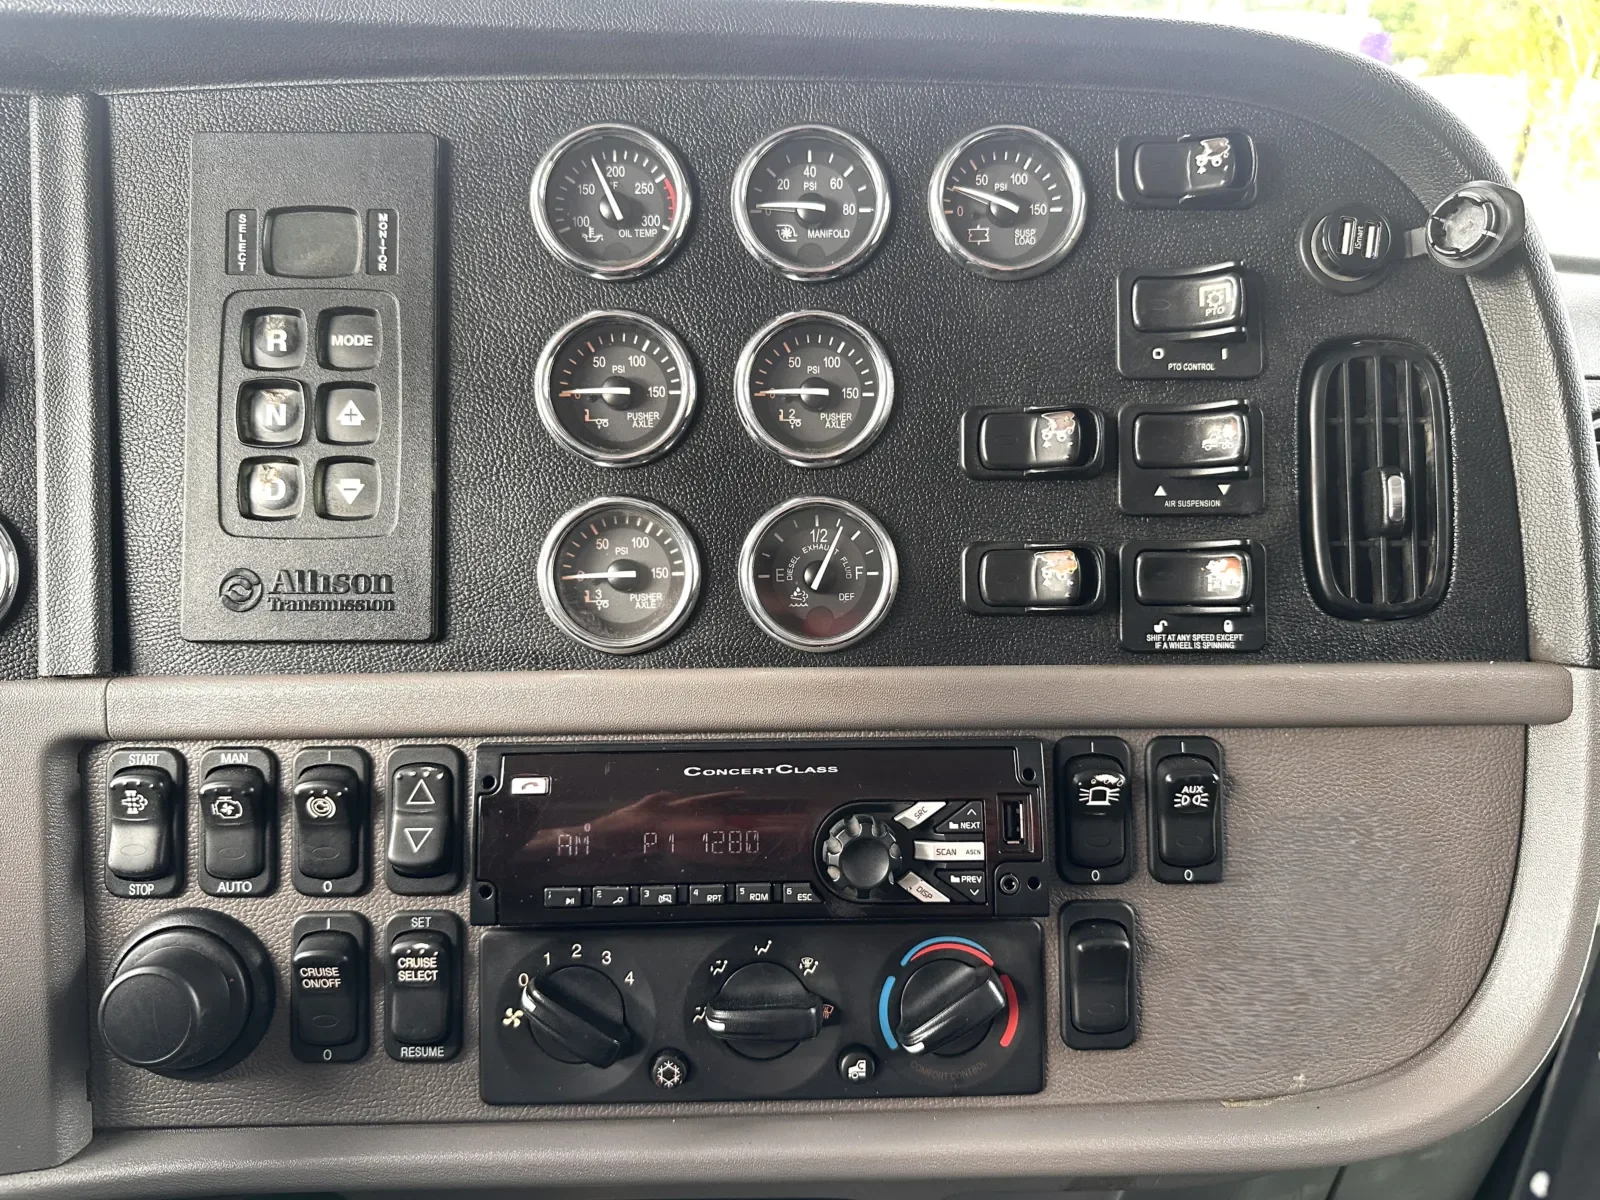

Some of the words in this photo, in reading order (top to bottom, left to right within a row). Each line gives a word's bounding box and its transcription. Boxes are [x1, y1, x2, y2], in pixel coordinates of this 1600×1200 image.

[606, 166, 625, 178] 200
[803, 166, 816, 178] 40
[777, 178, 790, 190] 20
[830, 178, 843, 190] 60
[976, 174, 988, 186] 50
[1010, 174, 1028, 185] 100
[578, 184, 595, 195] 150
[634, 183, 654, 195] 250
[804, 182, 817, 190] PSI
[994, 183, 1008, 191] PSI
[842, 204, 856, 215] 80
[956, 205, 964, 216] 0
[1029, 204, 1047, 215] 150
[572, 216, 590, 227] 100
[642, 216, 660, 227] 300
[618, 229, 632, 238] OIL
[635, 229, 658, 237] TEMP
[807, 229, 850, 238] MANIFOLD
[1014, 229, 1036, 238] SUSP
[238, 214, 248, 272] SELECT
[378, 214, 388, 272] MONITOR
[1014, 237, 1036, 245] LOAD
[1205, 306, 1224, 316] PTO
[266, 330, 287, 352] R
[331, 334, 373, 347] MODE
[592, 356, 606, 367] 50
[628, 356, 646, 367] 100
[788, 356, 801, 368] 50
[823, 356, 841, 368] 100
[1168, 363, 1182, 371] PTO
[1183, 363, 1215, 371] CONTROL
[612, 365, 625, 373] PSI
[807, 366, 820, 374] PSI
[648, 386, 665, 397] 150
[842, 388, 859, 399] 150
[265, 404, 287, 426] N
[627, 412, 660, 420] PUSHER
[820, 412, 852, 421] PUSHER
[632, 420, 654, 428] AXLE
[825, 420, 846, 428] AXLE
[264, 477, 286, 500] D
[810, 528, 828, 543] 1/2
[596, 539, 609, 550] 50
[631, 537, 649, 548] 100
[615, 547, 628, 555] PSI
[787, 556, 800, 580] DIESEL
[802, 544, 840, 555] EXHAUT
[840, 556, 852, 579] FLUID
[651, 568, 668, 578] 150
[776, 568, 784, 582] E
[855, 566, 863, 580] F
[268, 569, 395, 595] Allison
[630, 593, 662, 601] PUSHER
[839, 593, 855, 601] DEF
[268, 597, 395, 612] Transmission
[635, 601, 657, 609] AXLE
[128, 754, 159, 765] START
[221, 753, 249, 764] MAN
[1181, 785, 1204, 794] AUX
[914, 806, 928, 820] SRC
[558, 834, 590, 856] AM
[702, 830, 760, 854] 1280
[936, 848, 957, 856] SCAN
[128, 884, 154, 895] STOP
[217, 882, 252, 893] AUTO
[916, 885, 933, 900] DISP
[707, 894, 722, 902] RPT
[411, 917, 432, 928] SET
[571, 944, 582, 958] 2
[398, 957, 438, 968] CRUISE
[543, 952, 551, 966] 1
[601, 951, 612, 965] 3
[300, 967, 340, 977] CRUISE
[397, 970, 438, 981] SELECT
[302, 978, 341, 989] ON/OFF
[518, 973, 529, 987] 0
[624, 971, 634, 985] 4
[400, 1047, 445, 1057] RESUME
[911, 1060, 948, 1080] COMFORT
[950, 1060, 988, 1080] CONTROL
